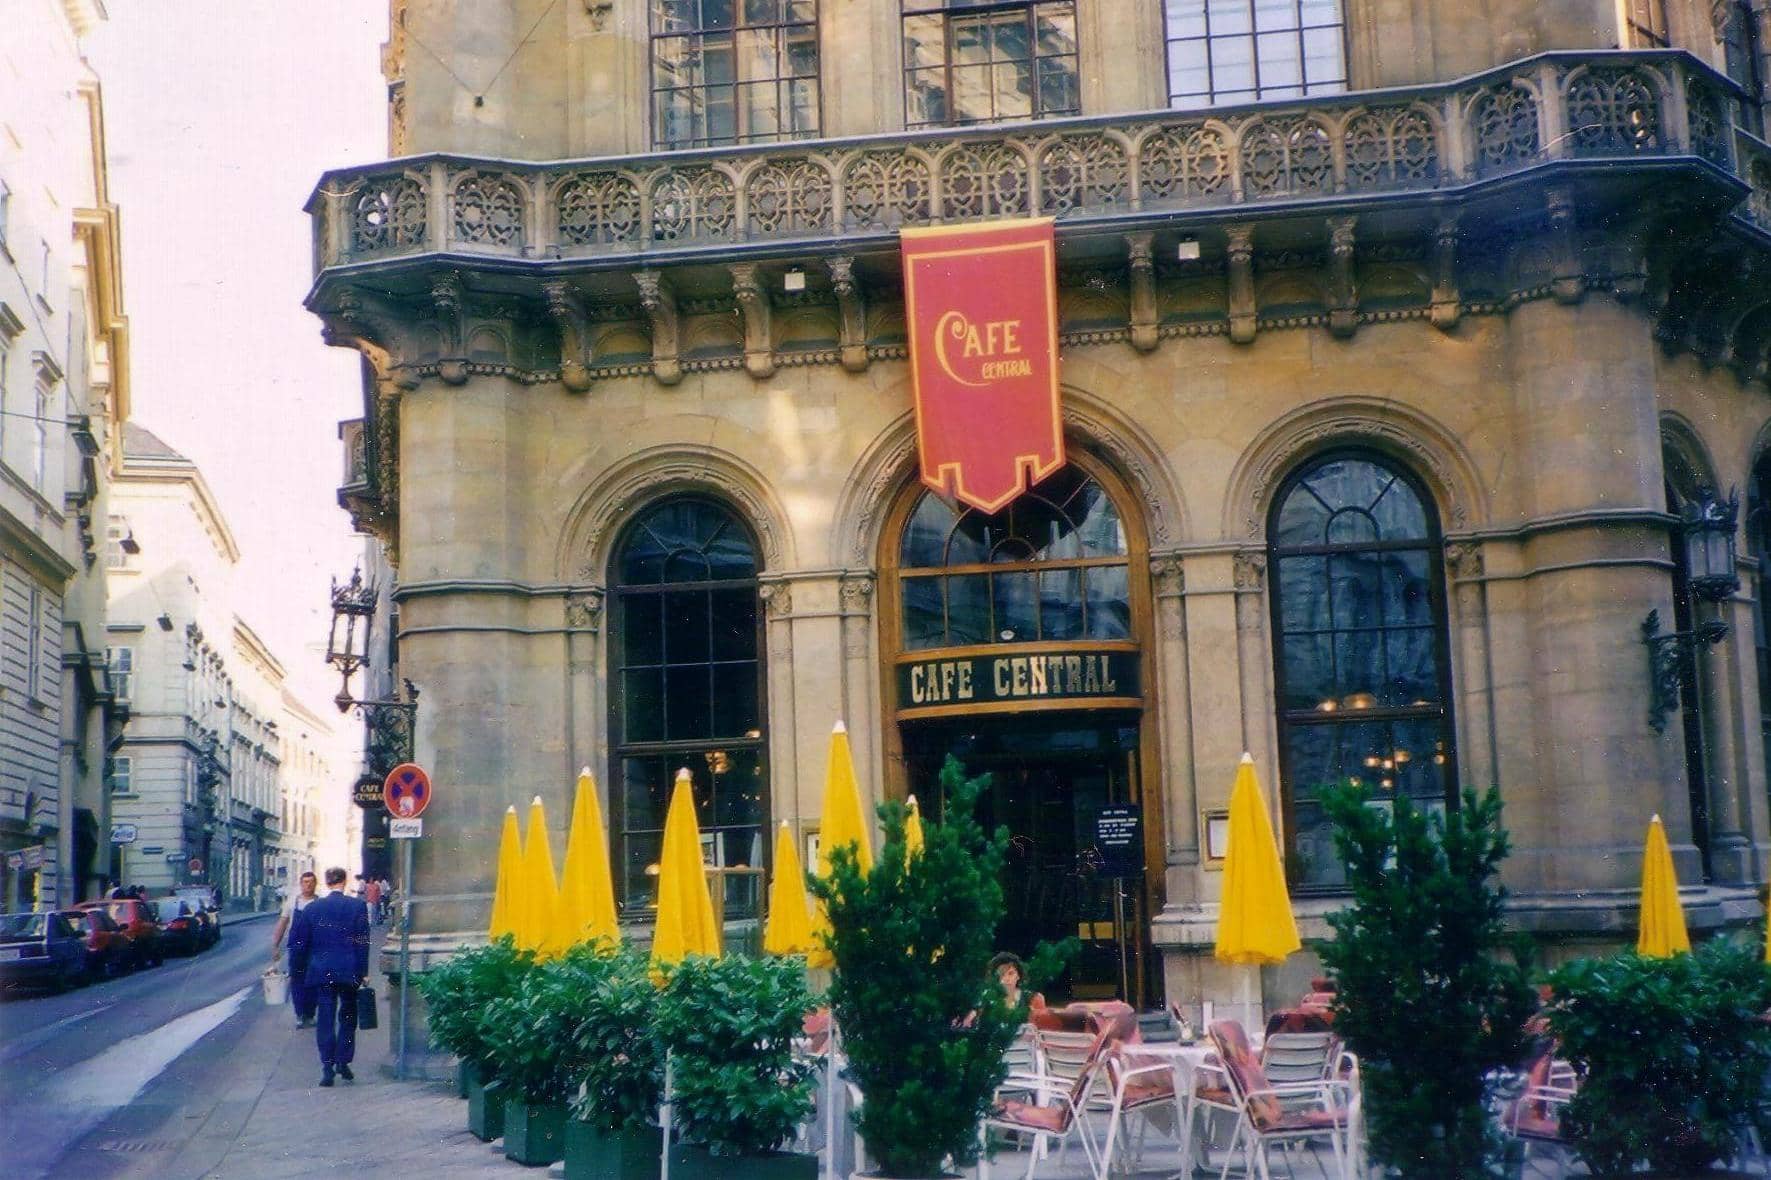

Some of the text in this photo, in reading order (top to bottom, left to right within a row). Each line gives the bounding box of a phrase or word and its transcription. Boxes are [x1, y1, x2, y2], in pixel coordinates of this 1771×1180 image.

[935, 311, 1021, 386] CAFE
[982, 359, 1032, 380] CENTRAL
[911, 655, 1116, 703] CAFE CENTRAL
[360, 784, 379, 793] CAFE
